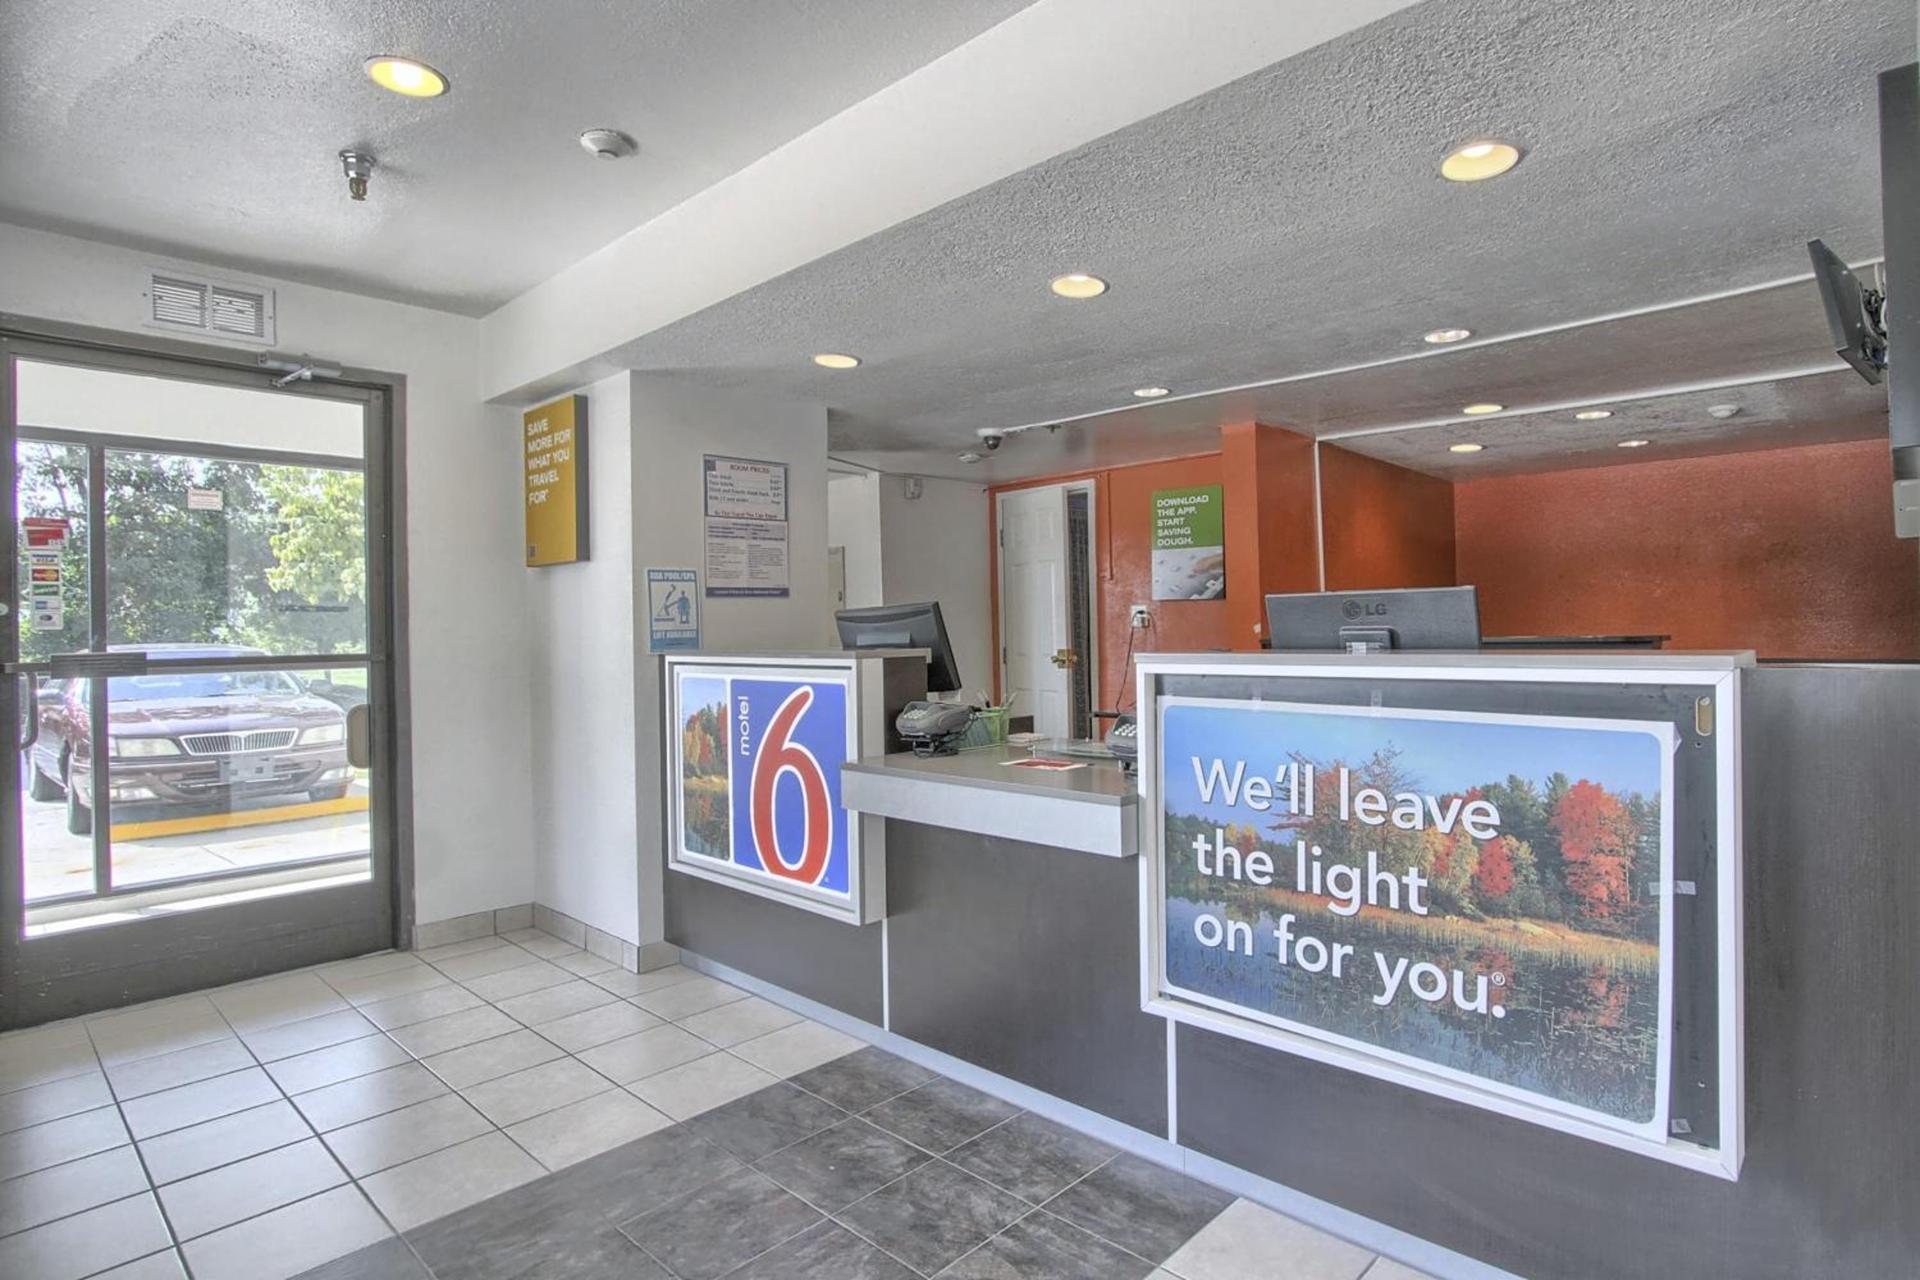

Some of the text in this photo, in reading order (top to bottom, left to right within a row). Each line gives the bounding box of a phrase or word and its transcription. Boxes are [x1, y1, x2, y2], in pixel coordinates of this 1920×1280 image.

[528, 419, 549, 436] SAVE
[528, 429, 571, 453] MORE FOR
[528, 449, 570, 471] WHAT YOU
[528, 470, 559, 487] TRAVEL
[1157, 495, 1209, 507] DOWNLOAD
[1157, 507, 1197, 516] THE APP.
[1157, 518, 1184, 527] START
[1157, 527, 1191, 537] SAVING
[1157, 537, 1193, 546] DOUGH.
[1365, 603, 1388, 616] LG
[737, 685, 833, 886] motel 6
[1190, 756, 1501, 840] We'll leave
[1192, 829, 1429, 917] the light
[1194, 913, 1254, 957] on
[1272, 914, 1354, 979] for
